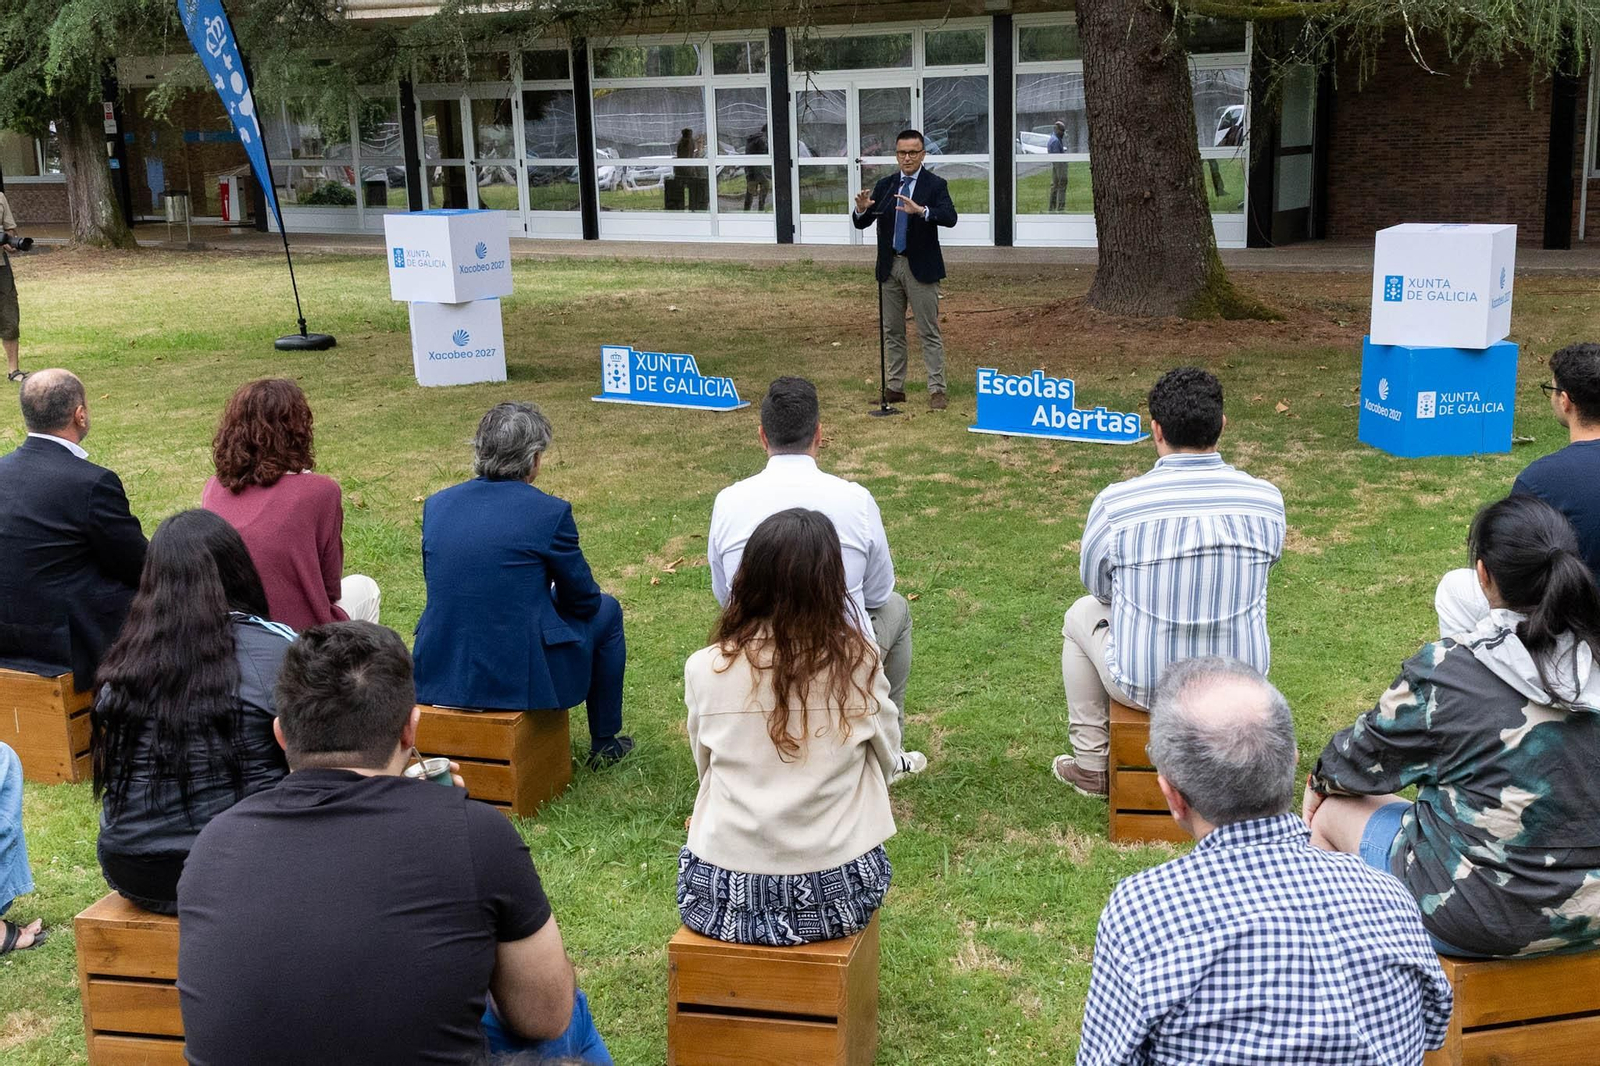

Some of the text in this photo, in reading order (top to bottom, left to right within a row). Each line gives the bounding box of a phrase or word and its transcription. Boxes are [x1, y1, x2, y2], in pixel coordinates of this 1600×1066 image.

[406, 249, 431, 258] XUNTA
[406, 259, 447, 268] DE GALICIA
[459, 260, 505, 274] Xacobeo 2027
[1408, 278, 1451, 289] XUNTA
[1407, 290, 1423, 301] DE
[1427, 291, 1478, 302] GALICIA
[428, 348, 496, 360] Xacobeo 2027
[635, 354, 695, 374] XUNTA
[635, 375, 734, 398] DE GALICIA
[978, 371, 1070, 400] Escolas
[1440, 391, 1480, 403] XUNTA
[1439, 402, 1505, 415] DE GALICIA
[1031, 404, 1137, 434] Abertas
